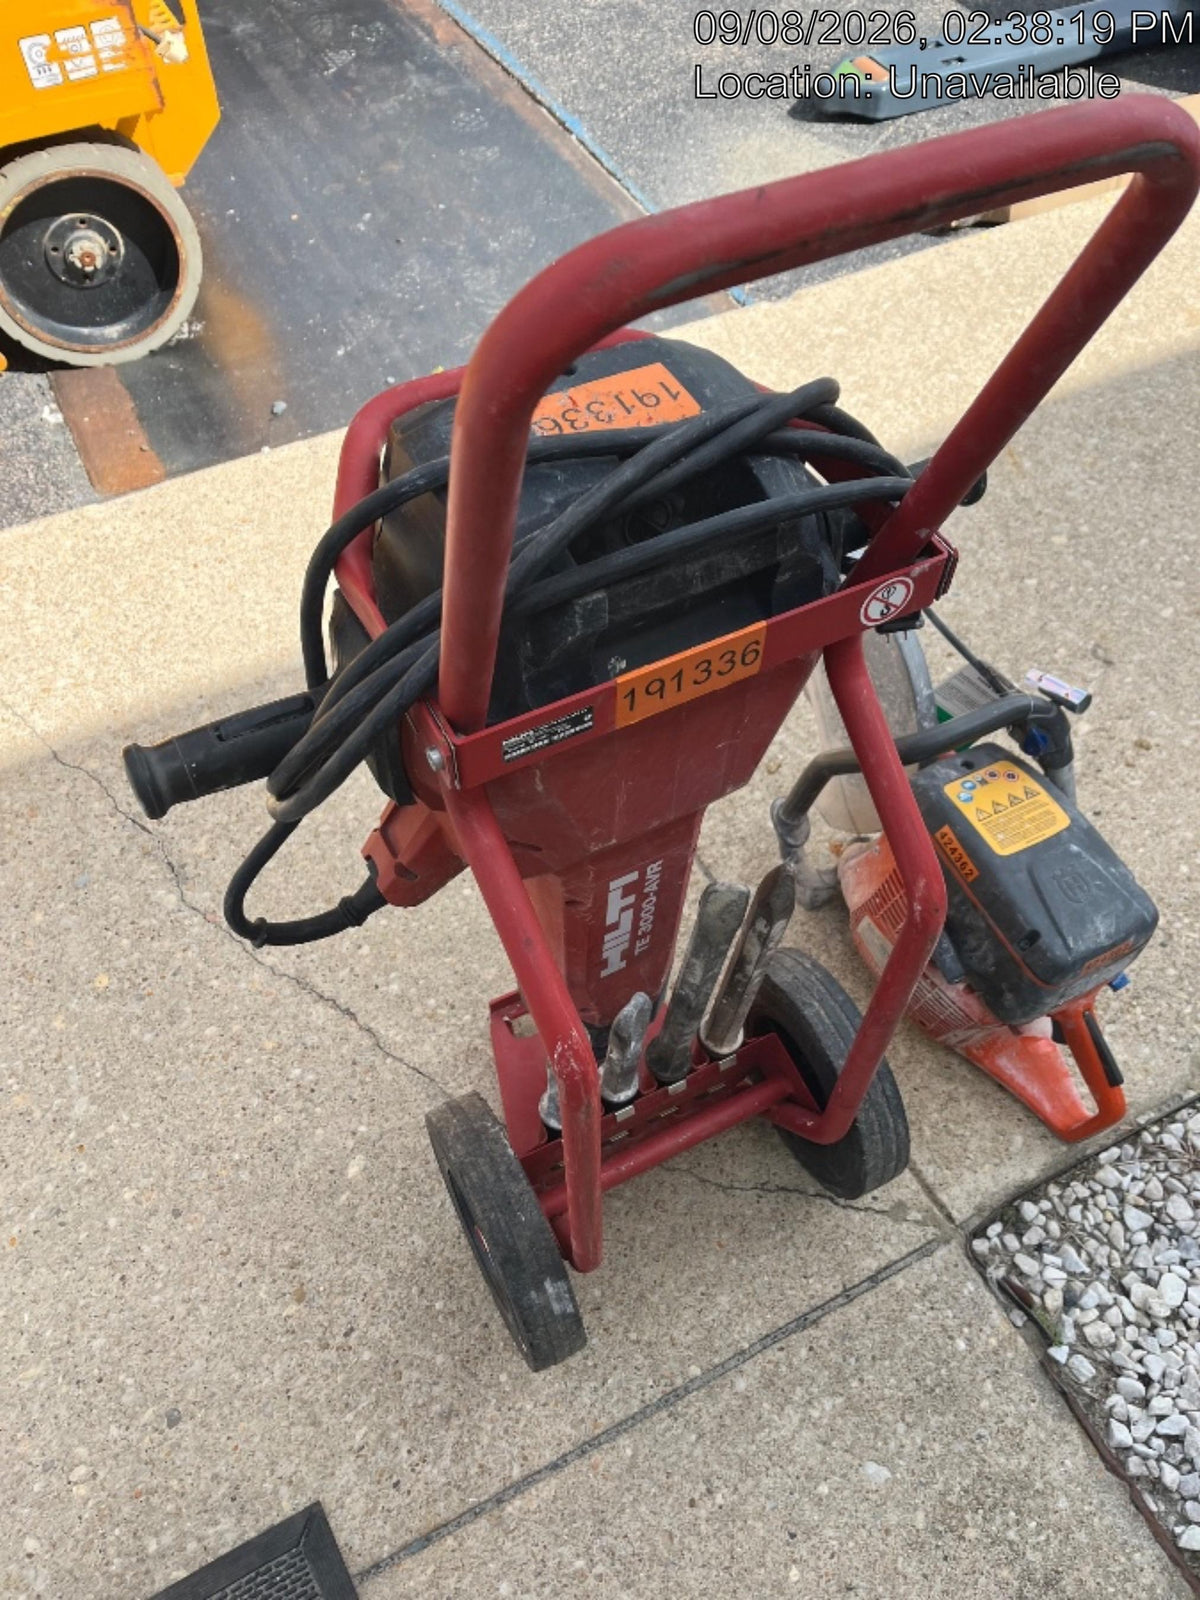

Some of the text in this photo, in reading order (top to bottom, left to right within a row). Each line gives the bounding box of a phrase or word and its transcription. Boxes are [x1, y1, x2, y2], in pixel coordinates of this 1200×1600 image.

[531, 381, 681, 434] 191336
[622, 639, 761, 712] 191336
[940, 831, 974, 879] 424362
[600, 870, 639, 978] HILTI
[634, 859, 664, 956] TE 3000-AVR
